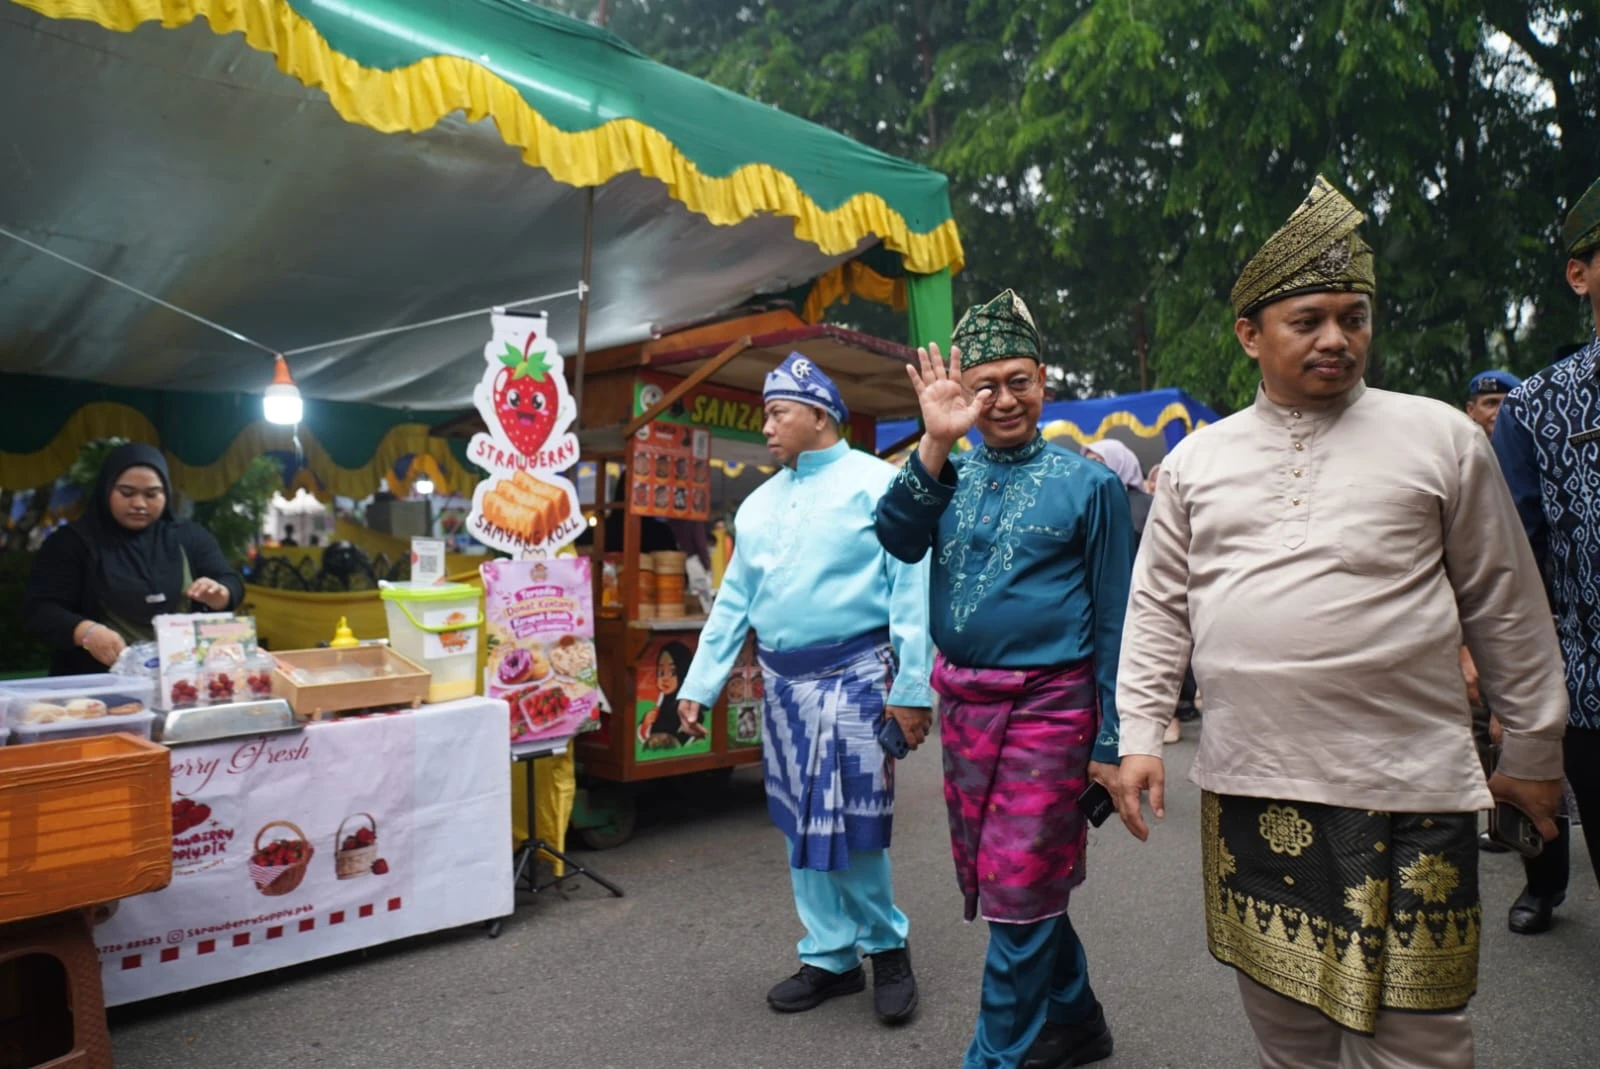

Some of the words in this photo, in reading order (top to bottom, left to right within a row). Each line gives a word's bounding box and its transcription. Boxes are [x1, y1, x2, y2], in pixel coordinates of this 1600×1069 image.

[476, 439, 575, 472] STRAWBERRY
[475, 514, 542, 548] SAMYANG
[547, 519, 579, 546] ROLL
[226, 735, 309, 774] Fresh
